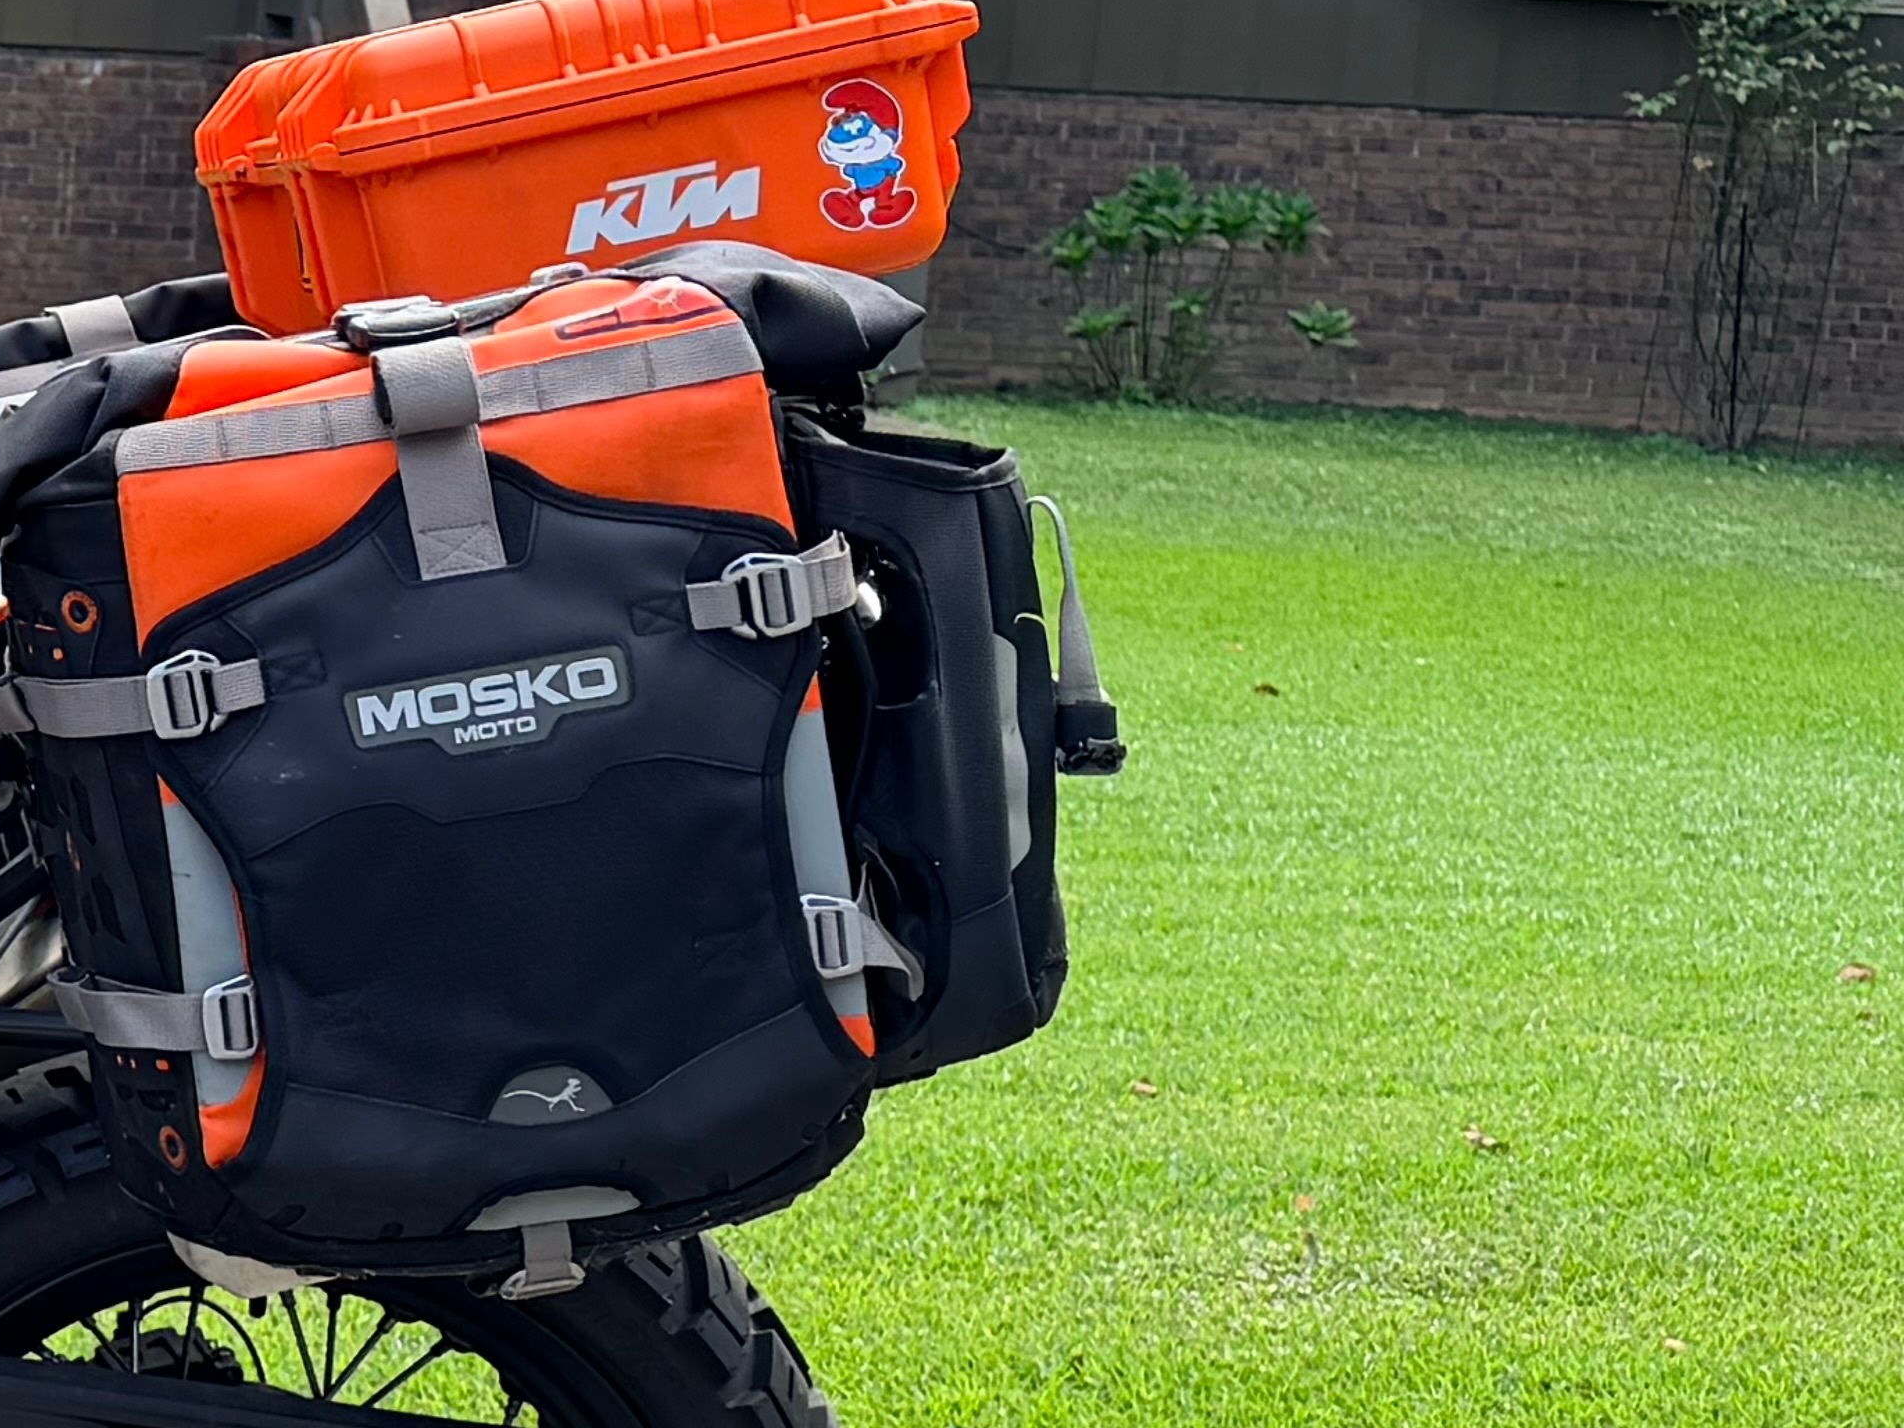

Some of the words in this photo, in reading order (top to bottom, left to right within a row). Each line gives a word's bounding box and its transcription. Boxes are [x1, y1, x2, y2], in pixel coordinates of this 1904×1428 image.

[565, 160, 760, 256] KTM
[356, 657, 617, 736] MOSKO
[454, 716, 537, 744] MOTO
